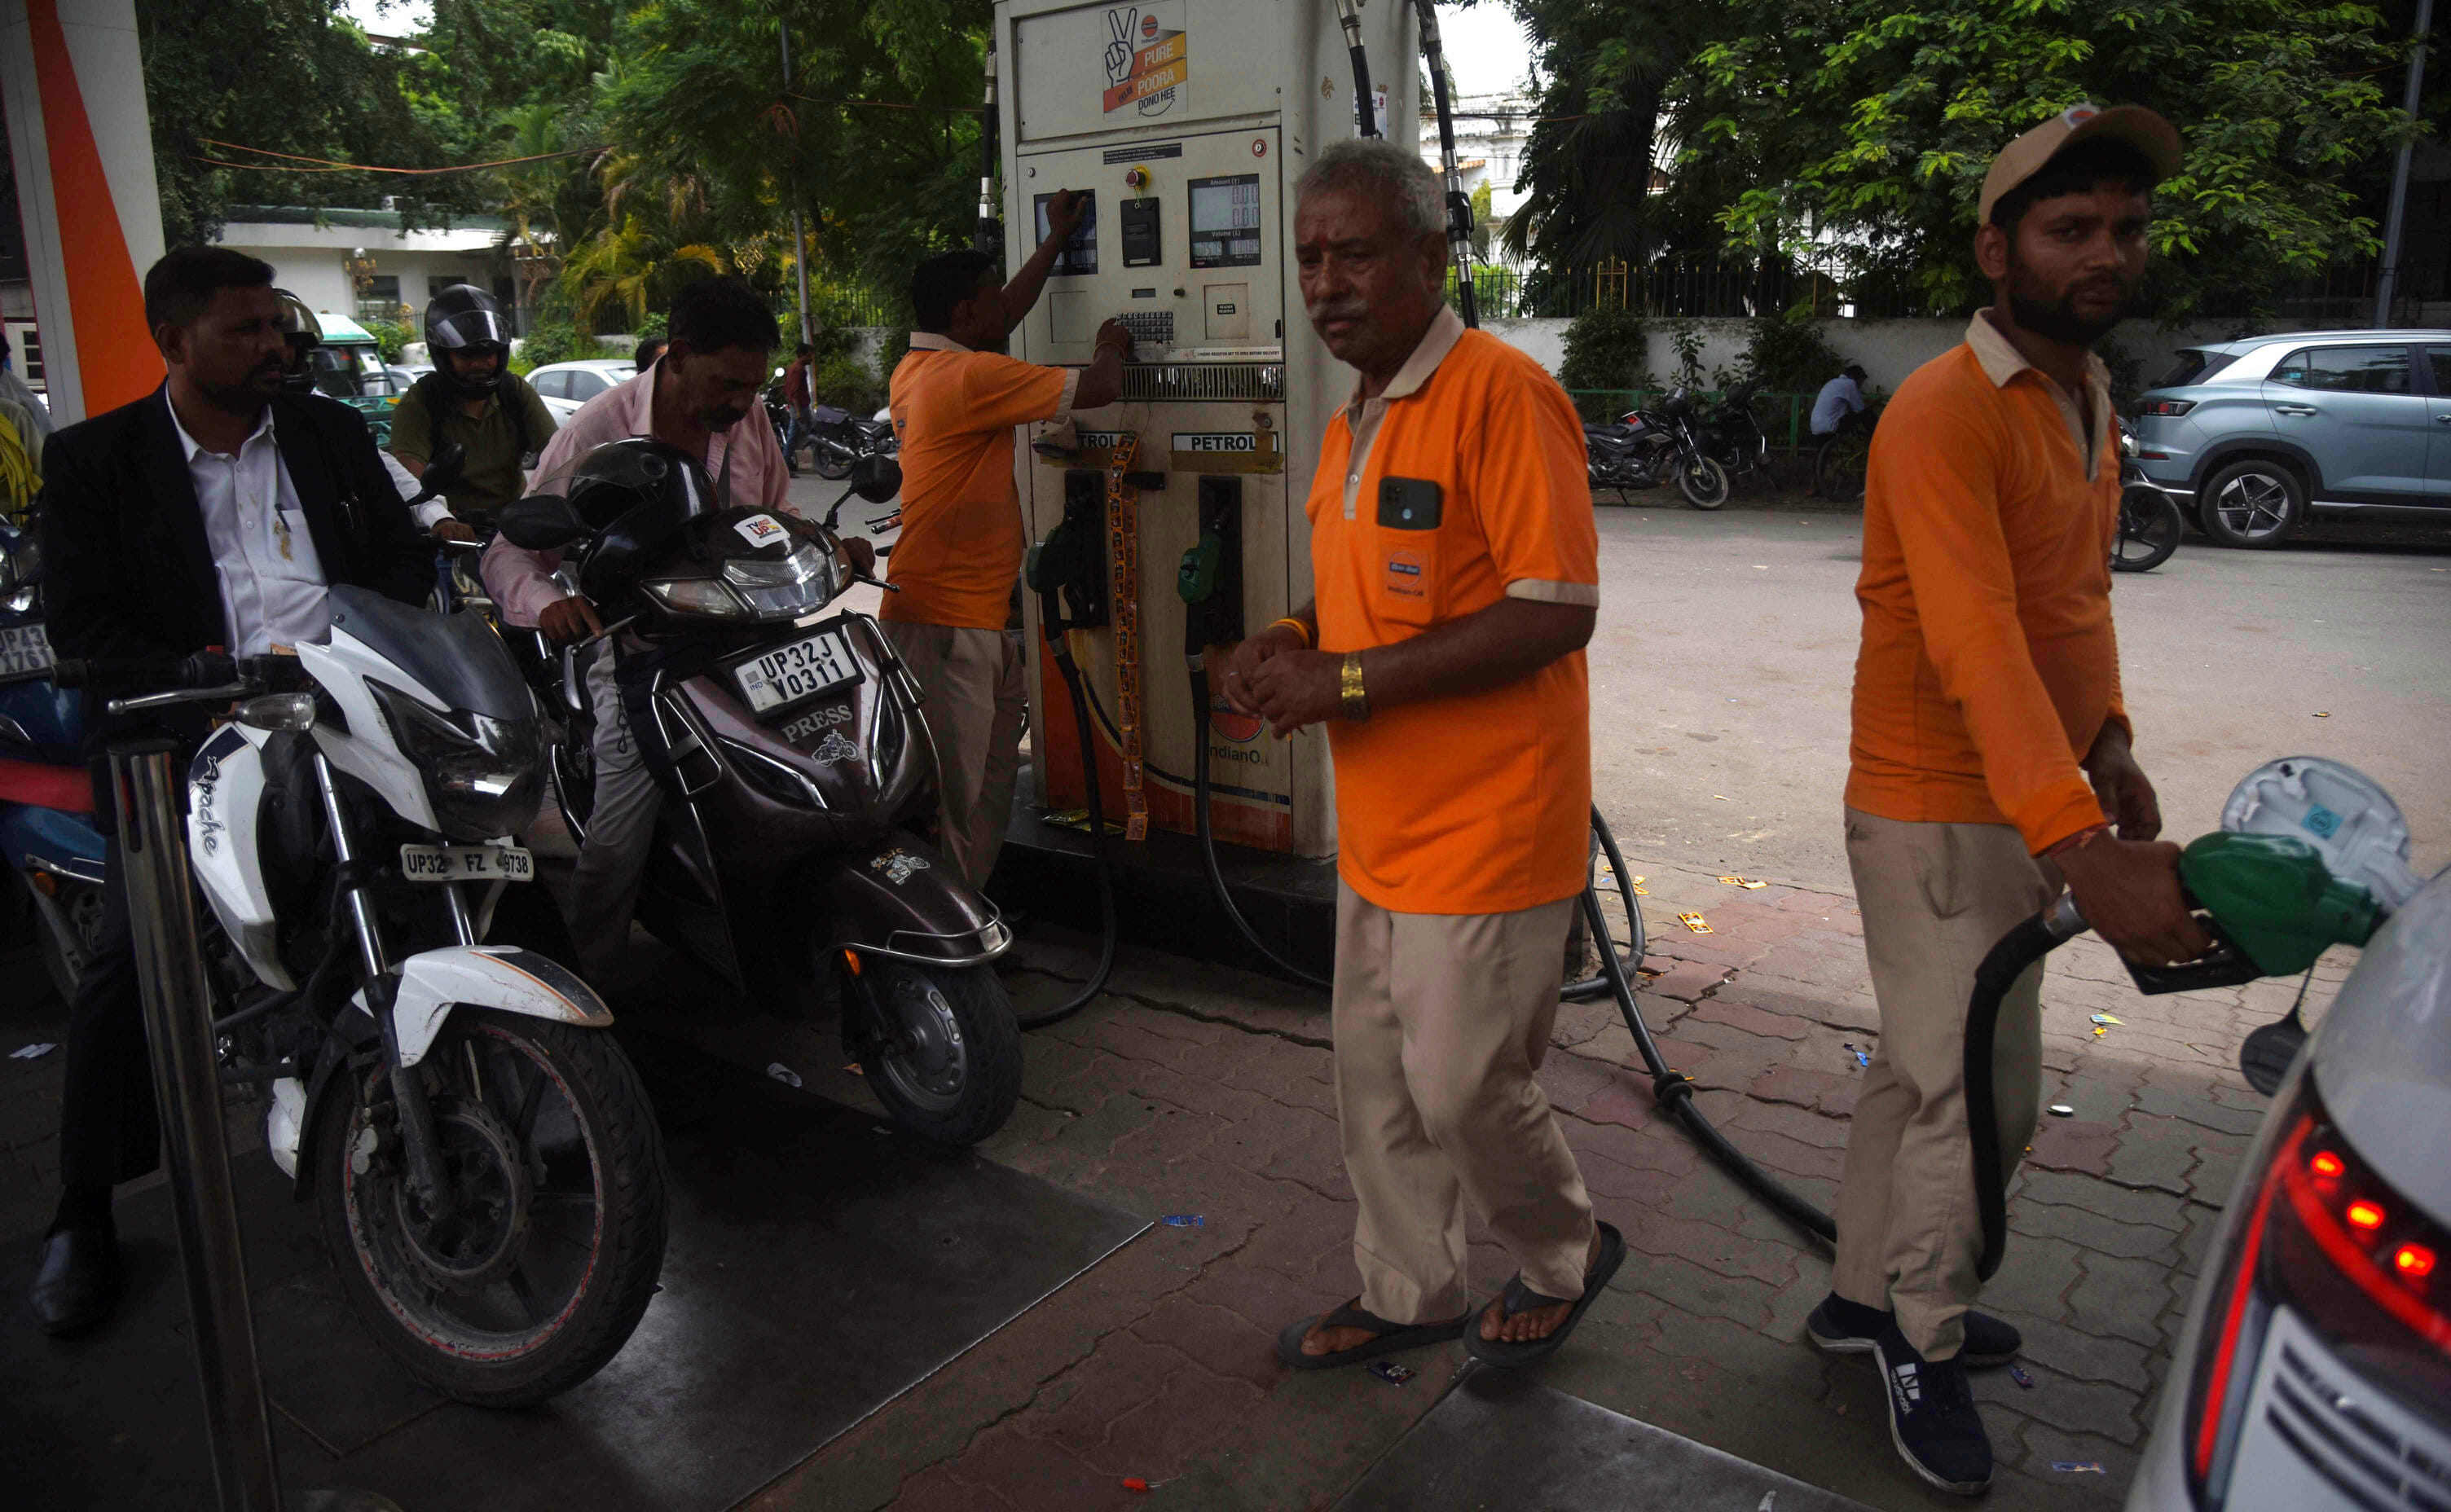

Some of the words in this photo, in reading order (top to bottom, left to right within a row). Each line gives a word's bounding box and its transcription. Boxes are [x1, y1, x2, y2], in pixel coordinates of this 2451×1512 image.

[1144, 42, 1173, 67] PURE
[1137, 68, 1175, 96] POORA
[1138, 94, 1159, 111] DONO
[1160, 86, 1176, 102] HEE
[1076, 434, 1117, 448] TROL
[1191, 436, 1256, 451] PETROL
[746, 521, 759, 530] TV
[751, 525, 770, 535] UP
[759, 636, 832, 679] UP32J
[749, 681, 763, 692] IND
[772, 658, 844, 701] V0311
[781, 704, 854, 744] PRESS
[193, 754, 226, 858] Apache
[407, 853, 446, 874] UP32
[464, 853, 486, 872] FZ
[503, 854, 529, 874] 9738
